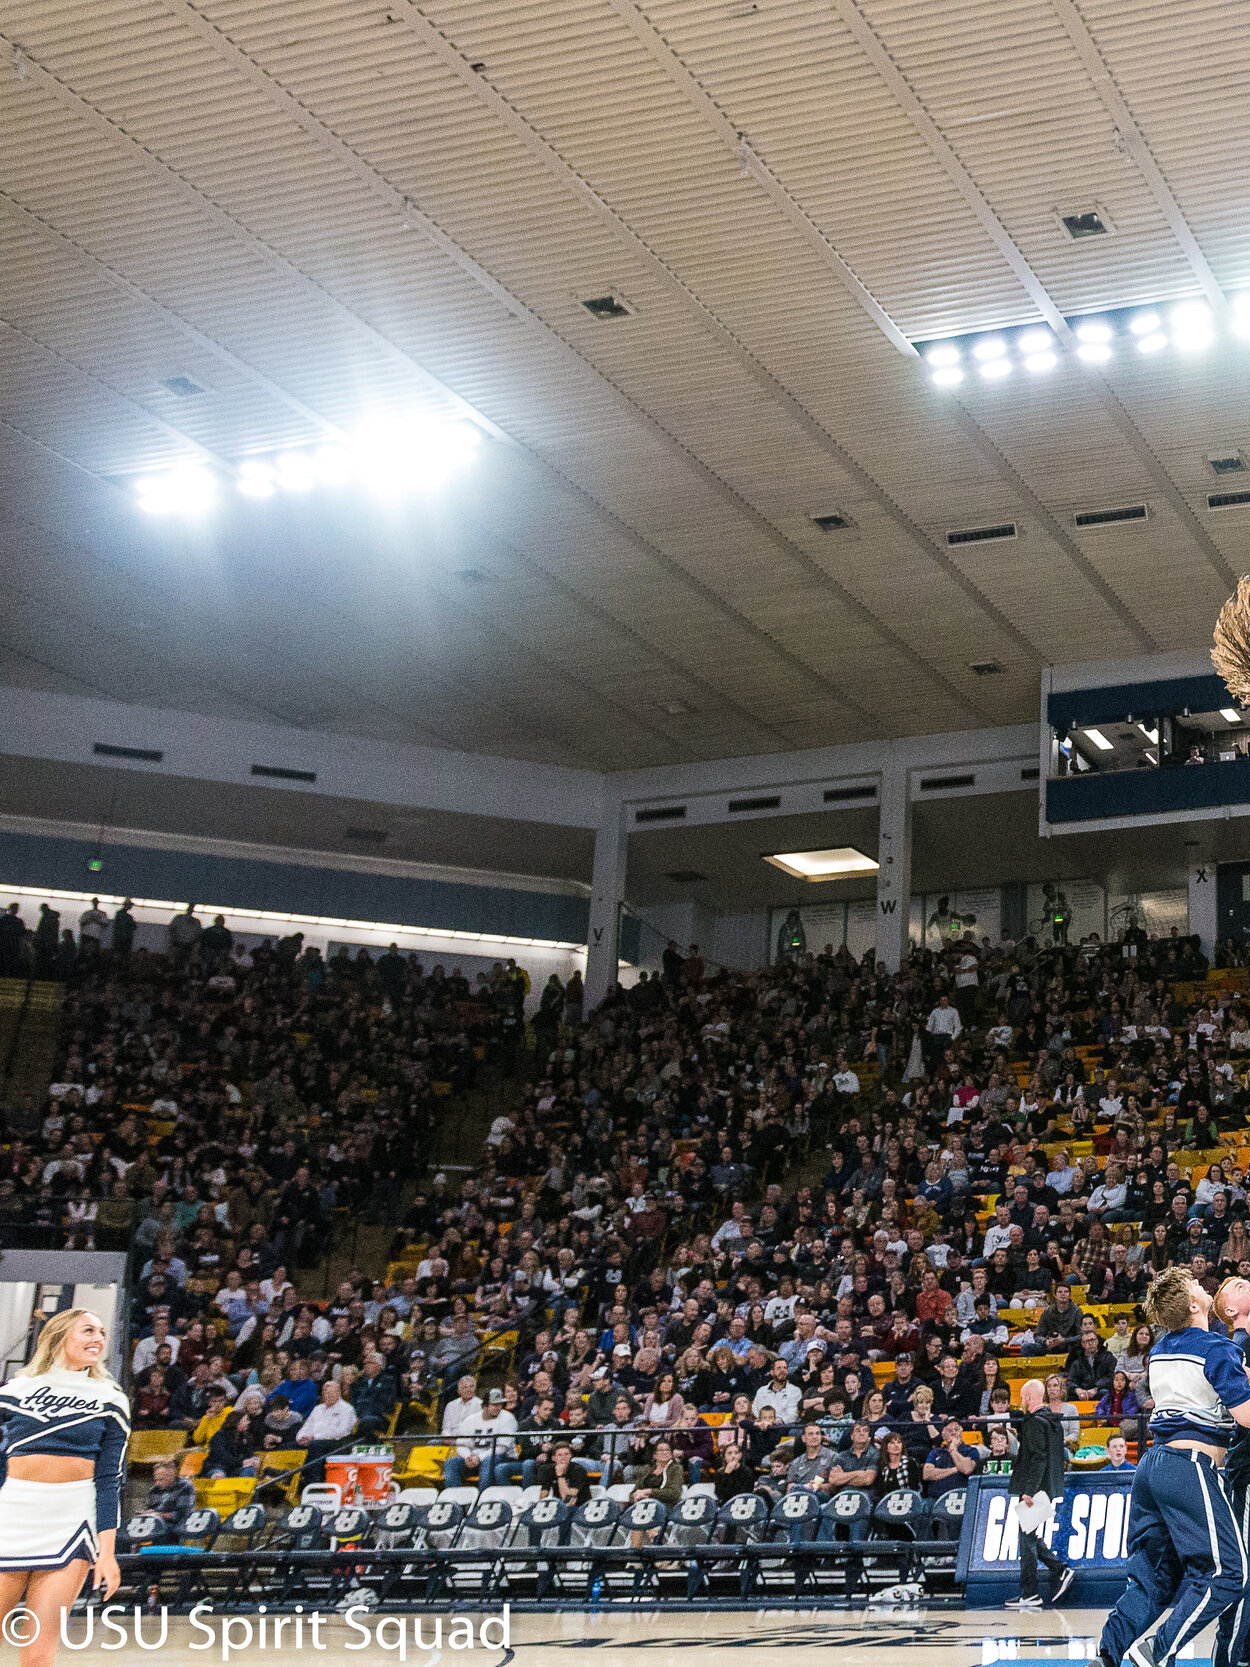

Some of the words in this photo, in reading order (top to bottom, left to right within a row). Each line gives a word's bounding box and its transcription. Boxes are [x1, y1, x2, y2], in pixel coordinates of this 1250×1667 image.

[1196, 868, 1208, 883] X
[881, 900, 896, 915] W
[593, 927, 604, 941] V
[25, 1386, 99, 1413] Aggies
[983, 1496, 1064, 1562] GAE
